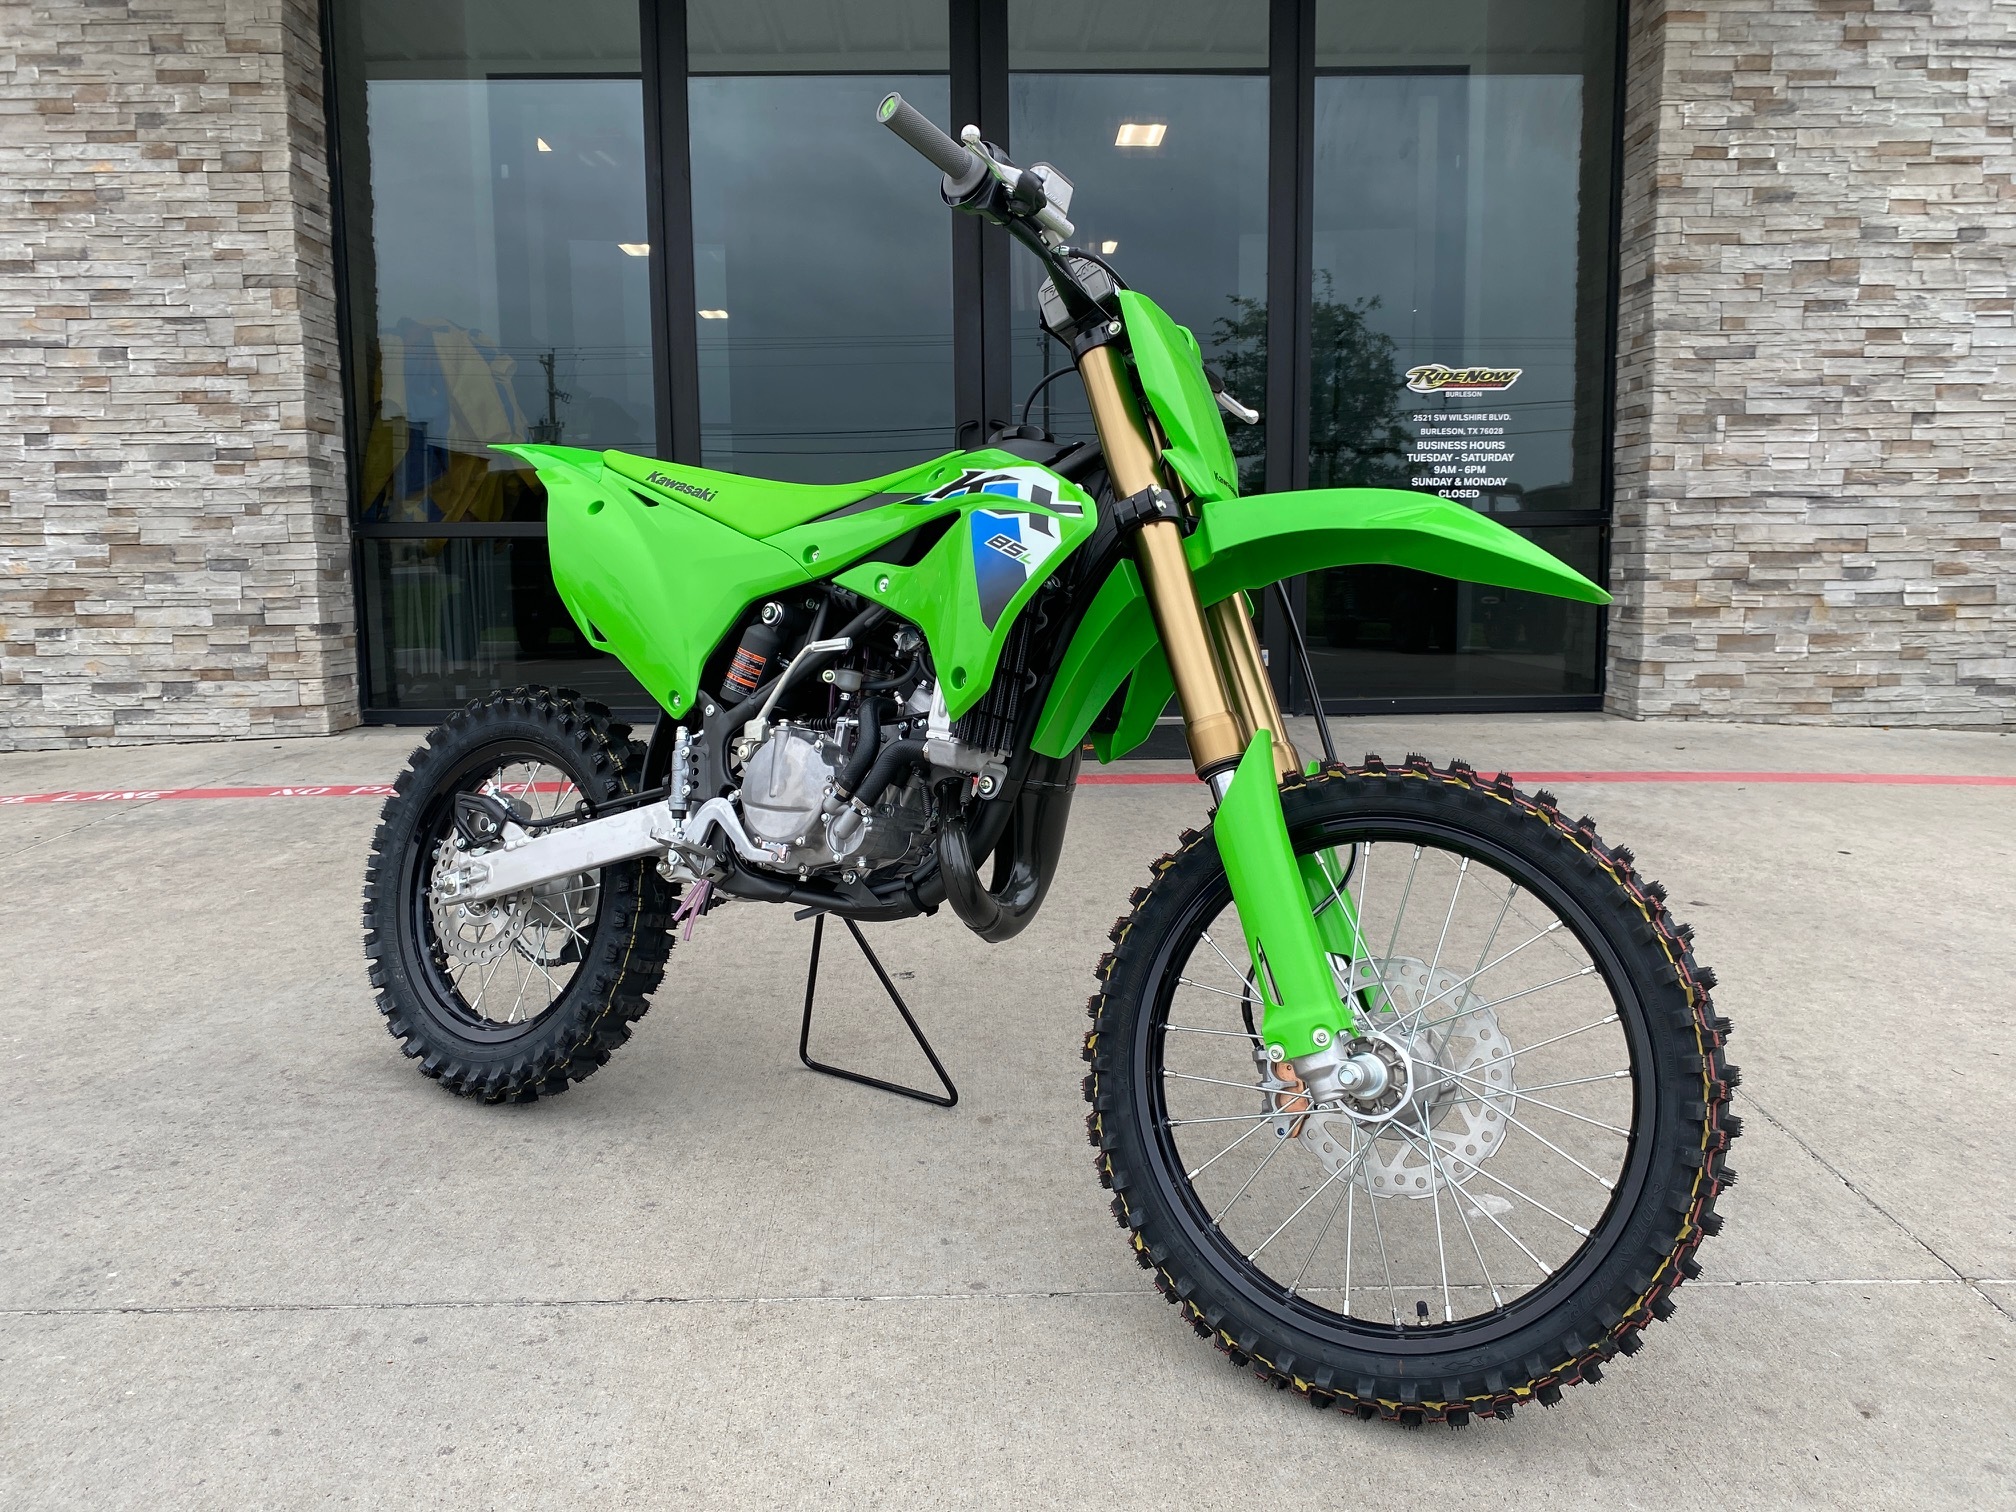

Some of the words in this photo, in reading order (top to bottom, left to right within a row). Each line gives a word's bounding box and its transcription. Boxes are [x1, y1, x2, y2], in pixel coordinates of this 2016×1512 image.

[1413, 414, 1432, 422] 2521
[1448, 413, 1487, 421] WILSHIRE
[1488, 413, 1512, 421] BLVD.
[1420, 428, 1466, 436] BURLESON,
[1467, 427, 1478, 435] TX
[1479, 427, 1504, 435] 76028
[1416, 441, 1468, 450] BUSINESS
[1469, 441, 1506, 450] HOURS
[1407, 453, 1453, 462] TUESDAY
[1460, 453, 1515, 462] SATURDAY
[1433, 465, 1457, 474] 9AM
[1464, 465, 1487, 474] 6PM
[1411, 477, 1453, 486] SUNDAY
[1454, 477, 1462, 486] &
[1463, 477, 1508, 486] MONDAY
[645, 471, 719, 502] Kawasaki
[1438, 489, 1480, 498] CLOSED
[51, 790, 177, 802] LANE
[269, 786, 332, 796] NO
